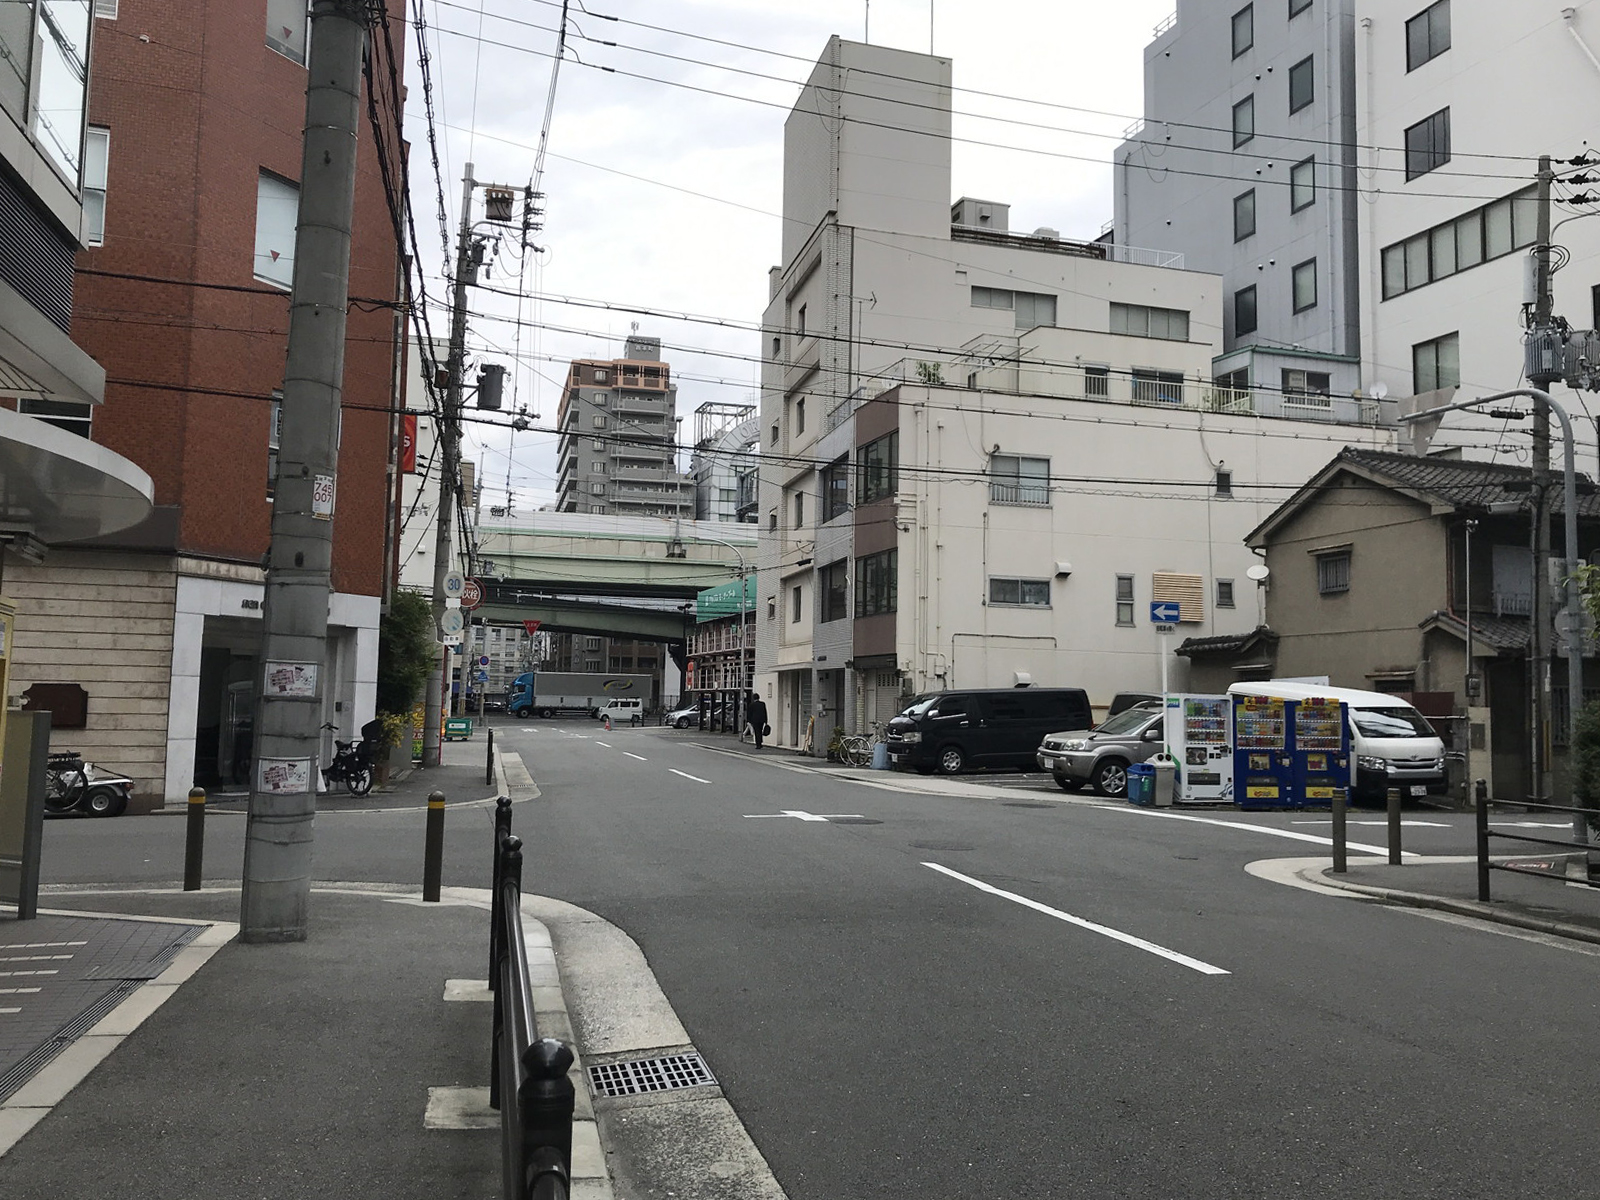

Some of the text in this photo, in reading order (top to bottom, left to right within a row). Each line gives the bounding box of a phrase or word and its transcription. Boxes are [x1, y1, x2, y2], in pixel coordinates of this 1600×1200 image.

[313, 492, 332, 503] 007
[447, 578, 461, 591] 30
[462, 589, 478, 600] 火栓
